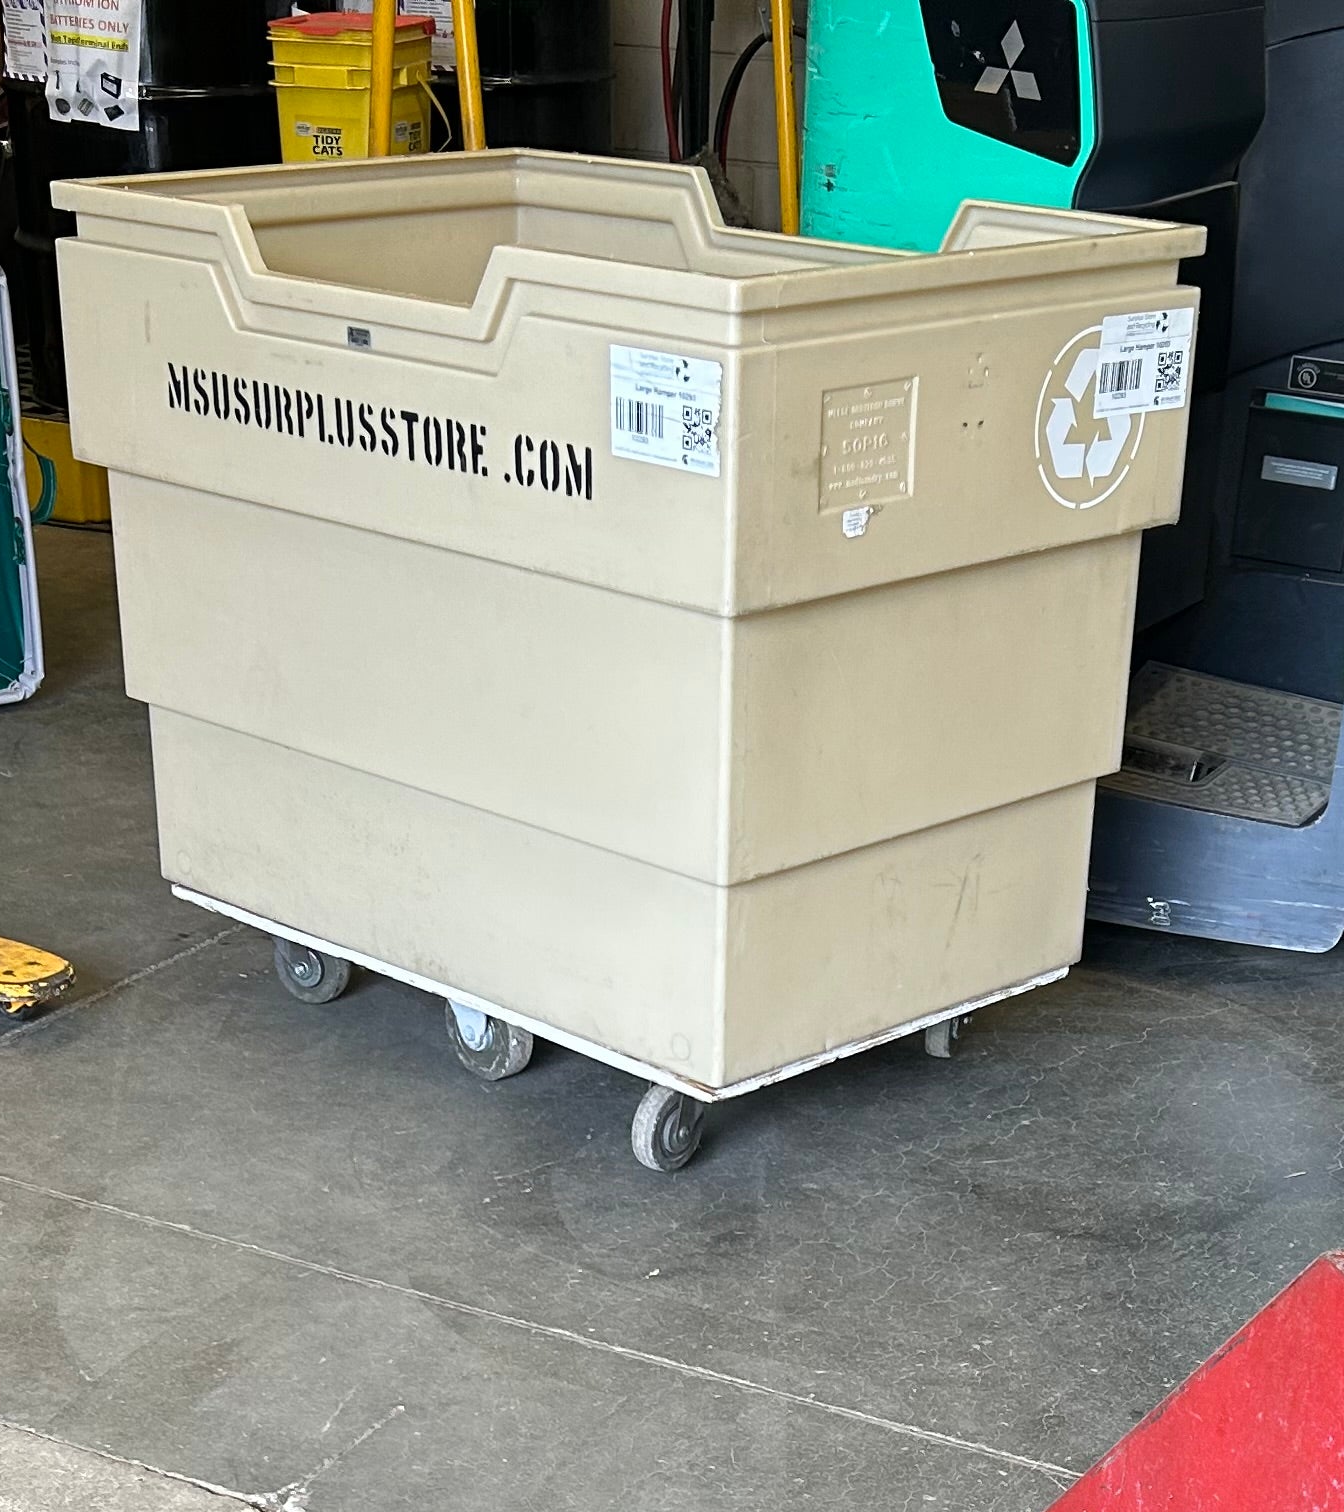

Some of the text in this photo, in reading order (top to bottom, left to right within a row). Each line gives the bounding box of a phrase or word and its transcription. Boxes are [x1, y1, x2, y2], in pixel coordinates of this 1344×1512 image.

[97, 20, 129, 34] ONLY
[312, 134, 341, 146] TIDY
[312, 145, 343, 156] CATS
[636, 384, 652, 395] Large
